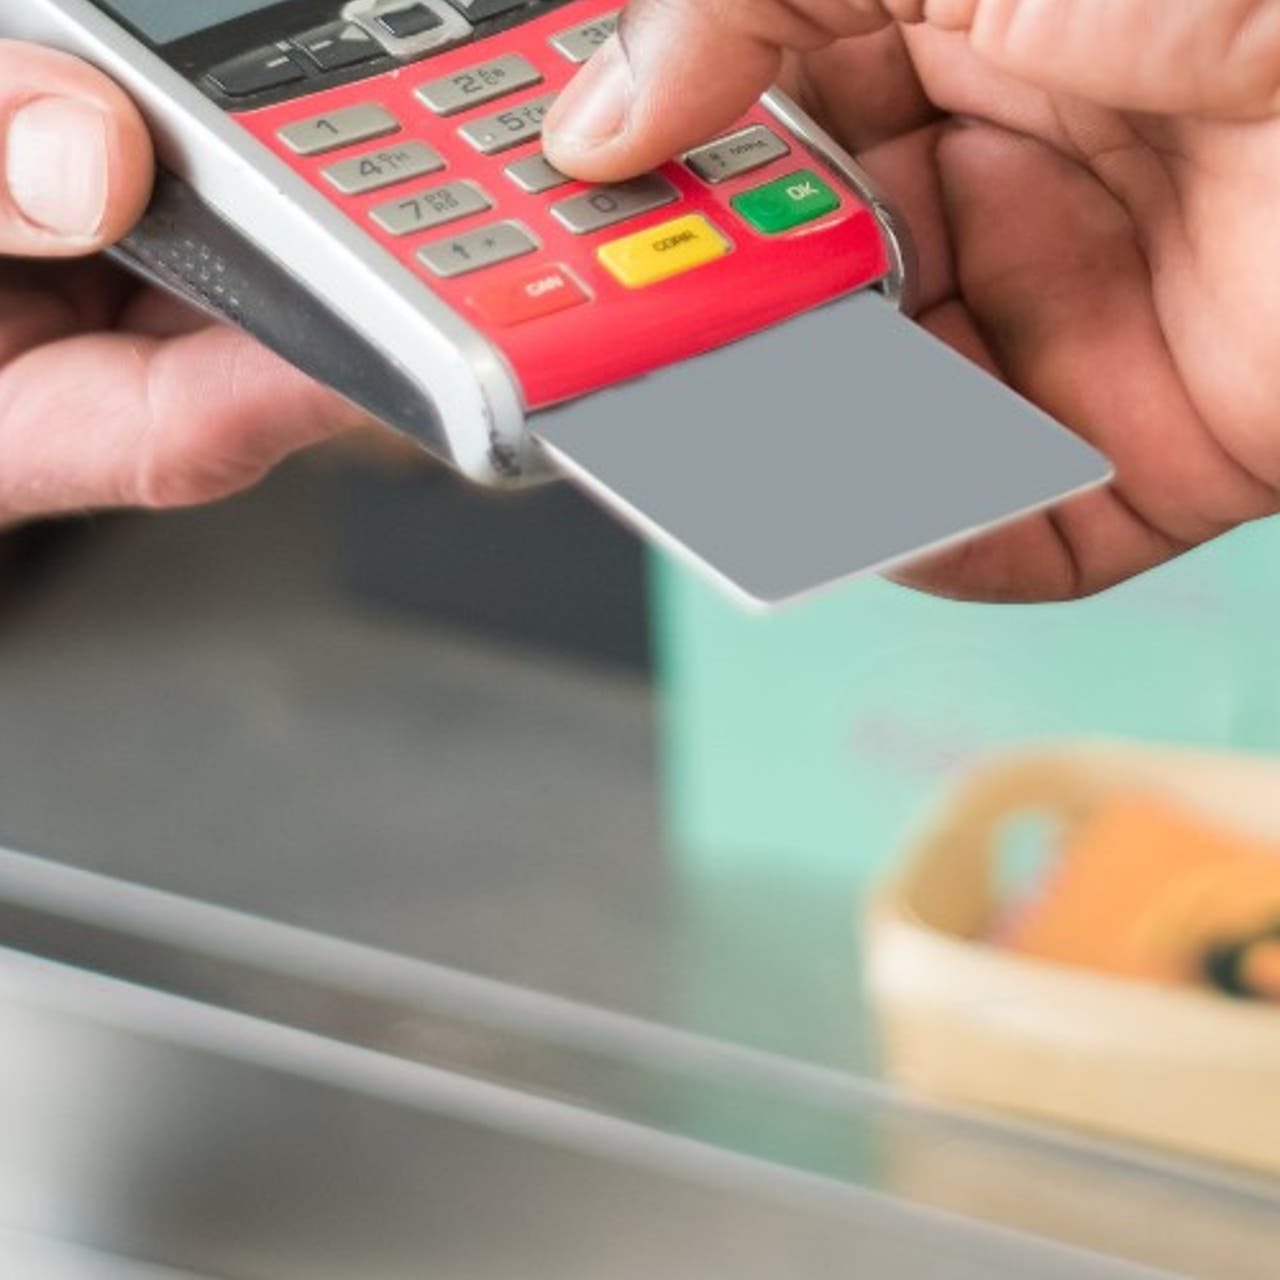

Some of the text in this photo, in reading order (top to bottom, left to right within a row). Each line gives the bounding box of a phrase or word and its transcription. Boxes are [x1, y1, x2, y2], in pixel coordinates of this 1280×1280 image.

[452, 73, 483, 94] 2
[316, 119, 339, 134] 1
[497, 111, 525, 132] 5
[360, 160, 383, 176] 4
[785, 181, 818, 201] OK
[399, 200, 421, 220] 7
[590, 193, 618, 213] 0
